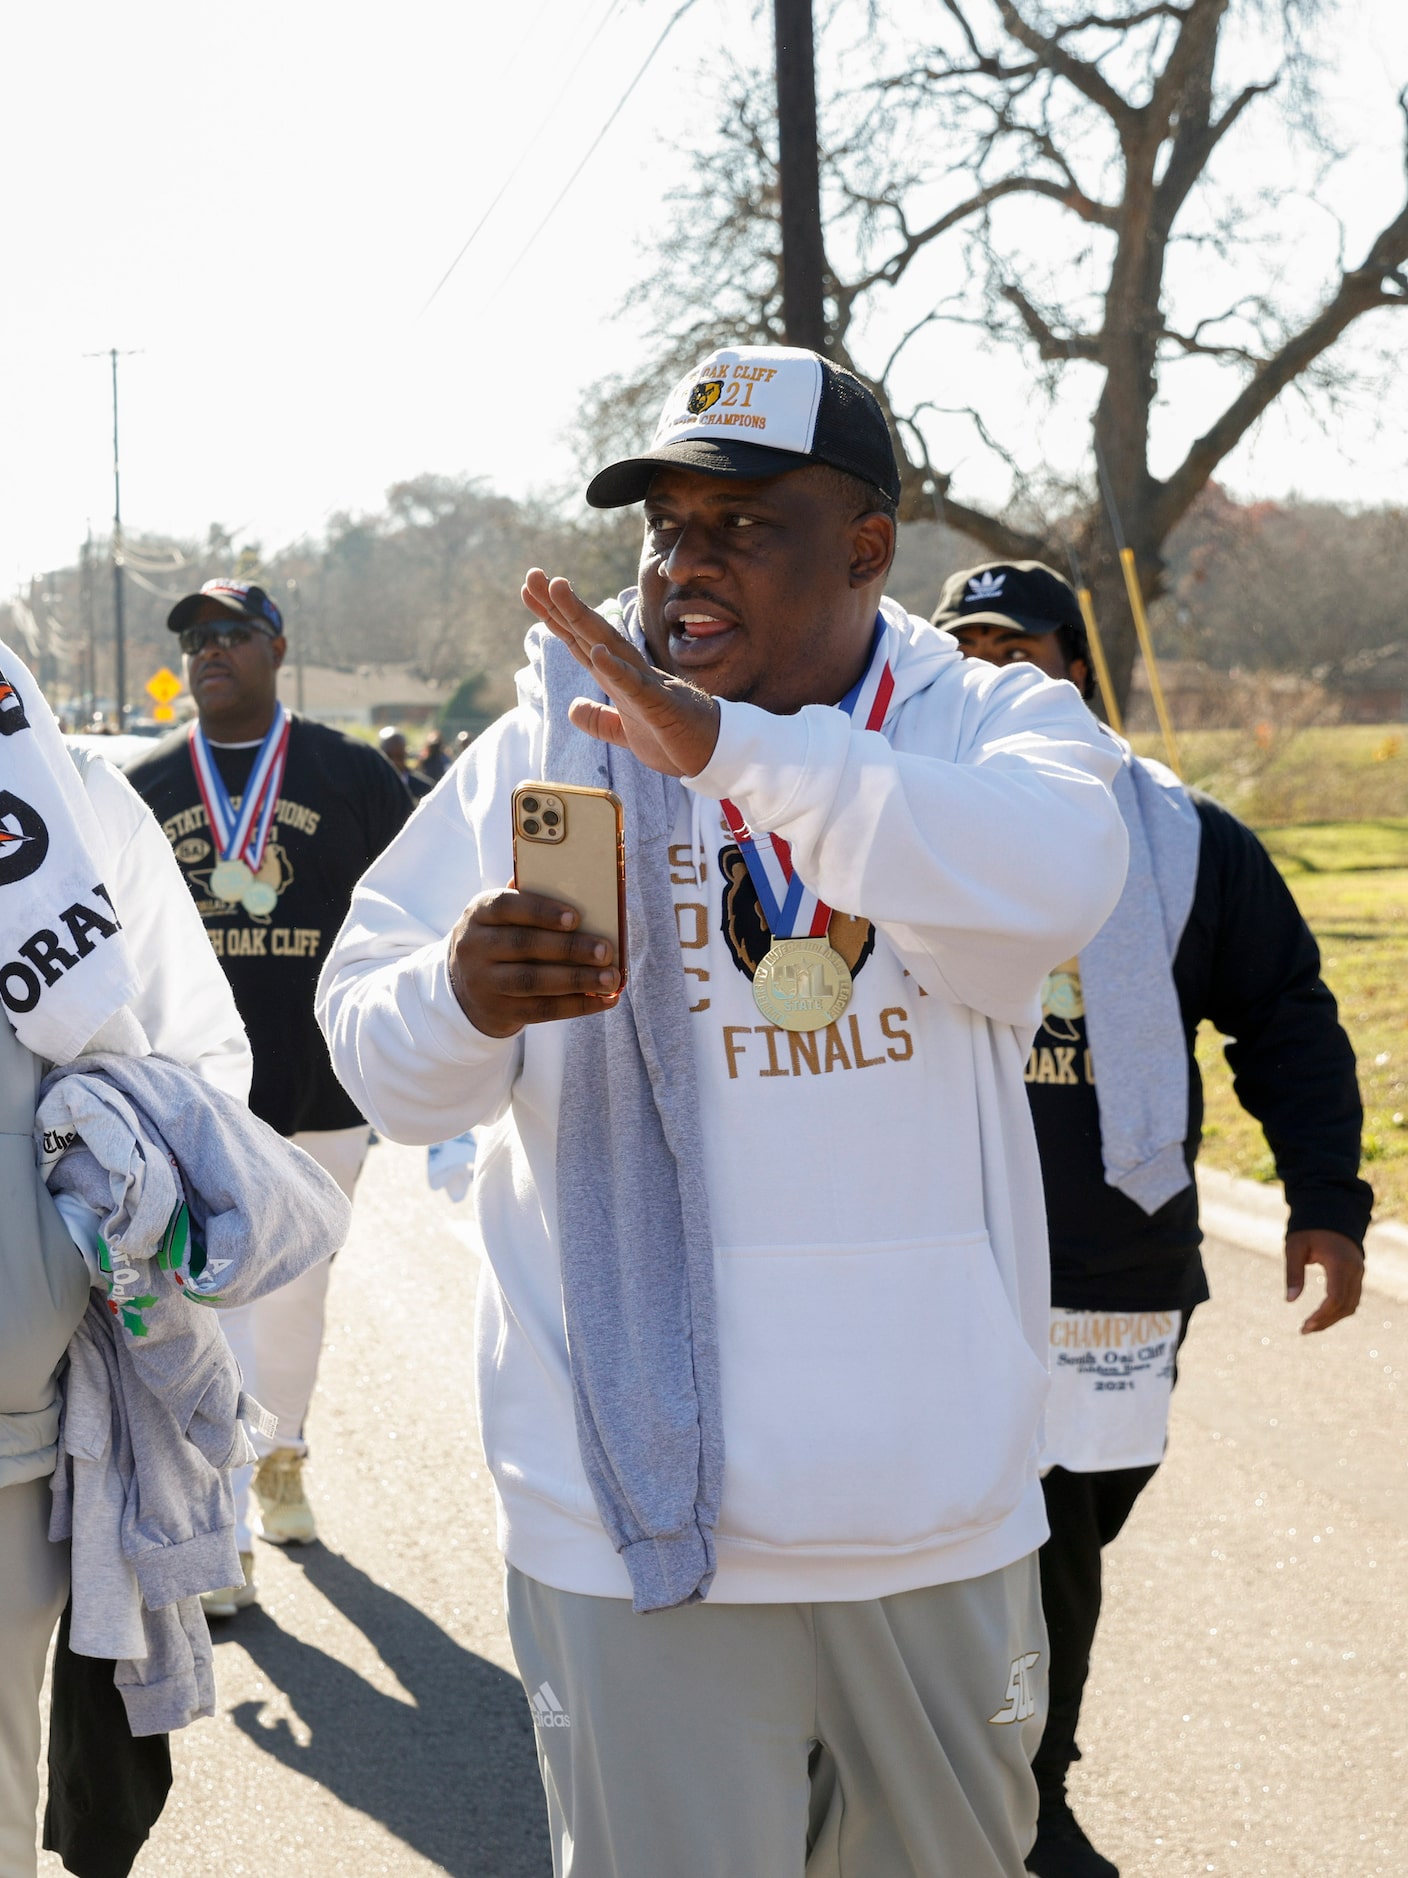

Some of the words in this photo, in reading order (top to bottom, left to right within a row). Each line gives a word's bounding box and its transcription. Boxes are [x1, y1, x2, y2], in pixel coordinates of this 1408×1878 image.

[733, 365, 778, 383] CLIFF
[699, 413, 767, 430] CHAMPIONS
[226, 927, 268, 957] OAK
[271, 927, 322, 958] CLIFF
[783, 999, 824, 1012] STATE
[722, 1006, 914, 1080] FINALS
[1049, 1311, 1174, 1349] CHAMPIONS
[1094, 1380, 1136, 1392] 2021
[533, 1710, 572, 1728] didas
